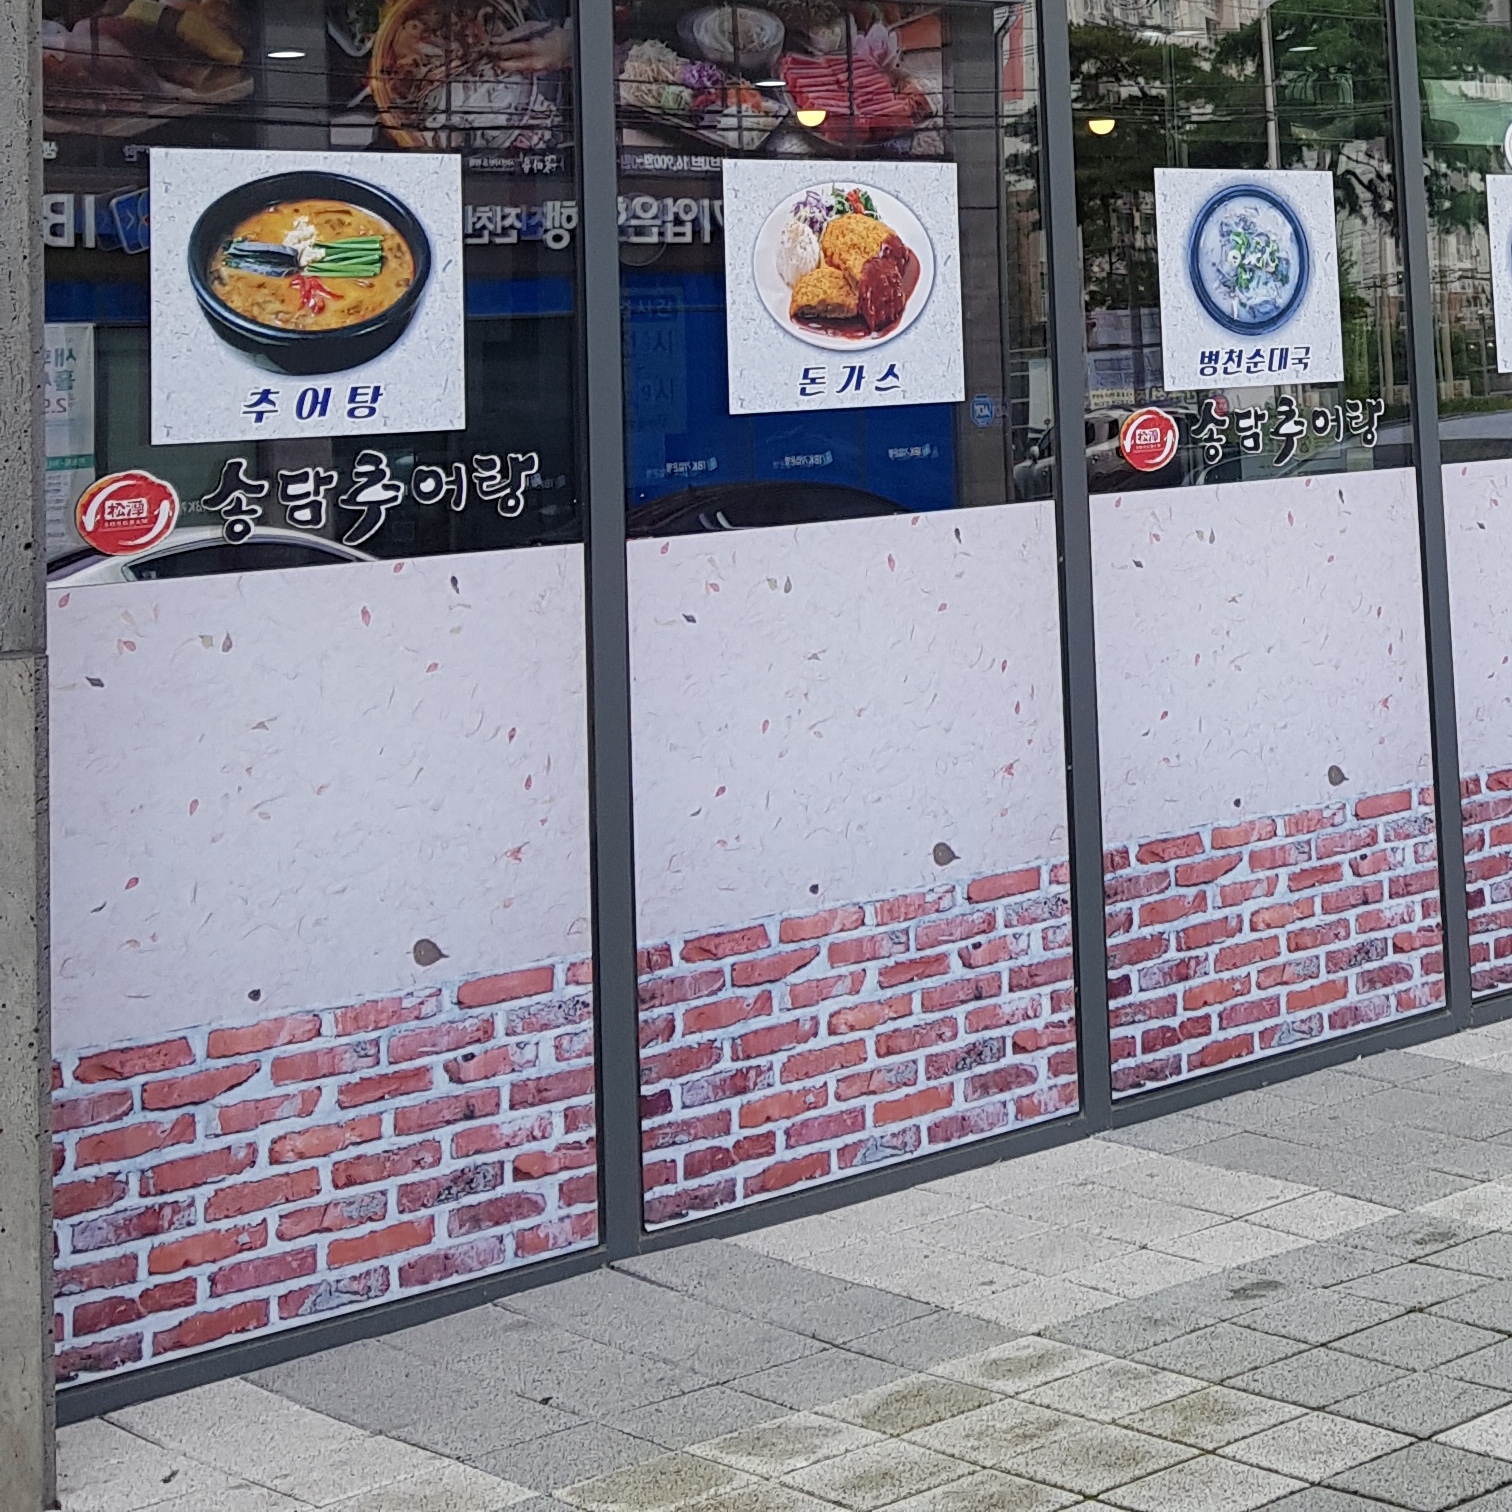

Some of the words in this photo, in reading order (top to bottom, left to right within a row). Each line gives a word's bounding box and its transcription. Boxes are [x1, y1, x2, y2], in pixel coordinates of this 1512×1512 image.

[1199, 346, 1312, 377] 병천순대국
[1191, 394, 1384, 467] 송담추어탕
[202, 449, 539, 545] 송담추어탕
